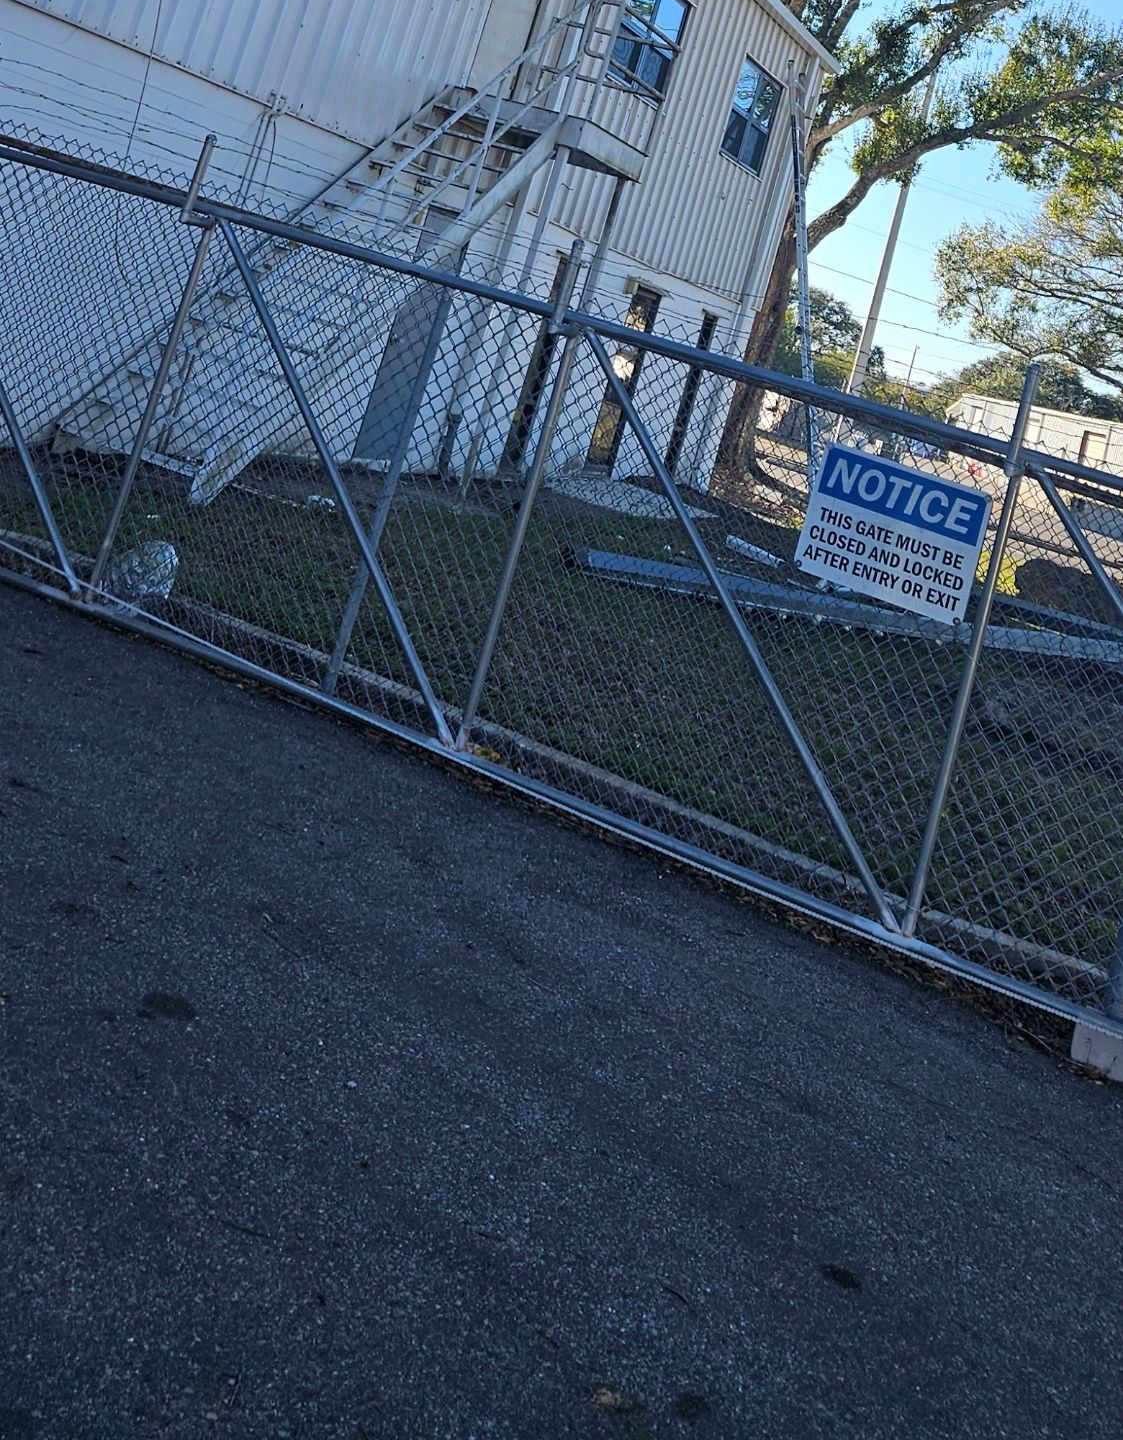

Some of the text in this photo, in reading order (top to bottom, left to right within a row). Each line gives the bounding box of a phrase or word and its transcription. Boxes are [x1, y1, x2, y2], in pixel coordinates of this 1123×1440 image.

[827, 458, 979, 534] NOTICE
[810, 525, 963, 591] CLOSED AND LOCKED
[820, 507, 964, 570] THIS GATE MUST BE
[803, 545, 960, 611] AFTER ENTRY OR EXIT
